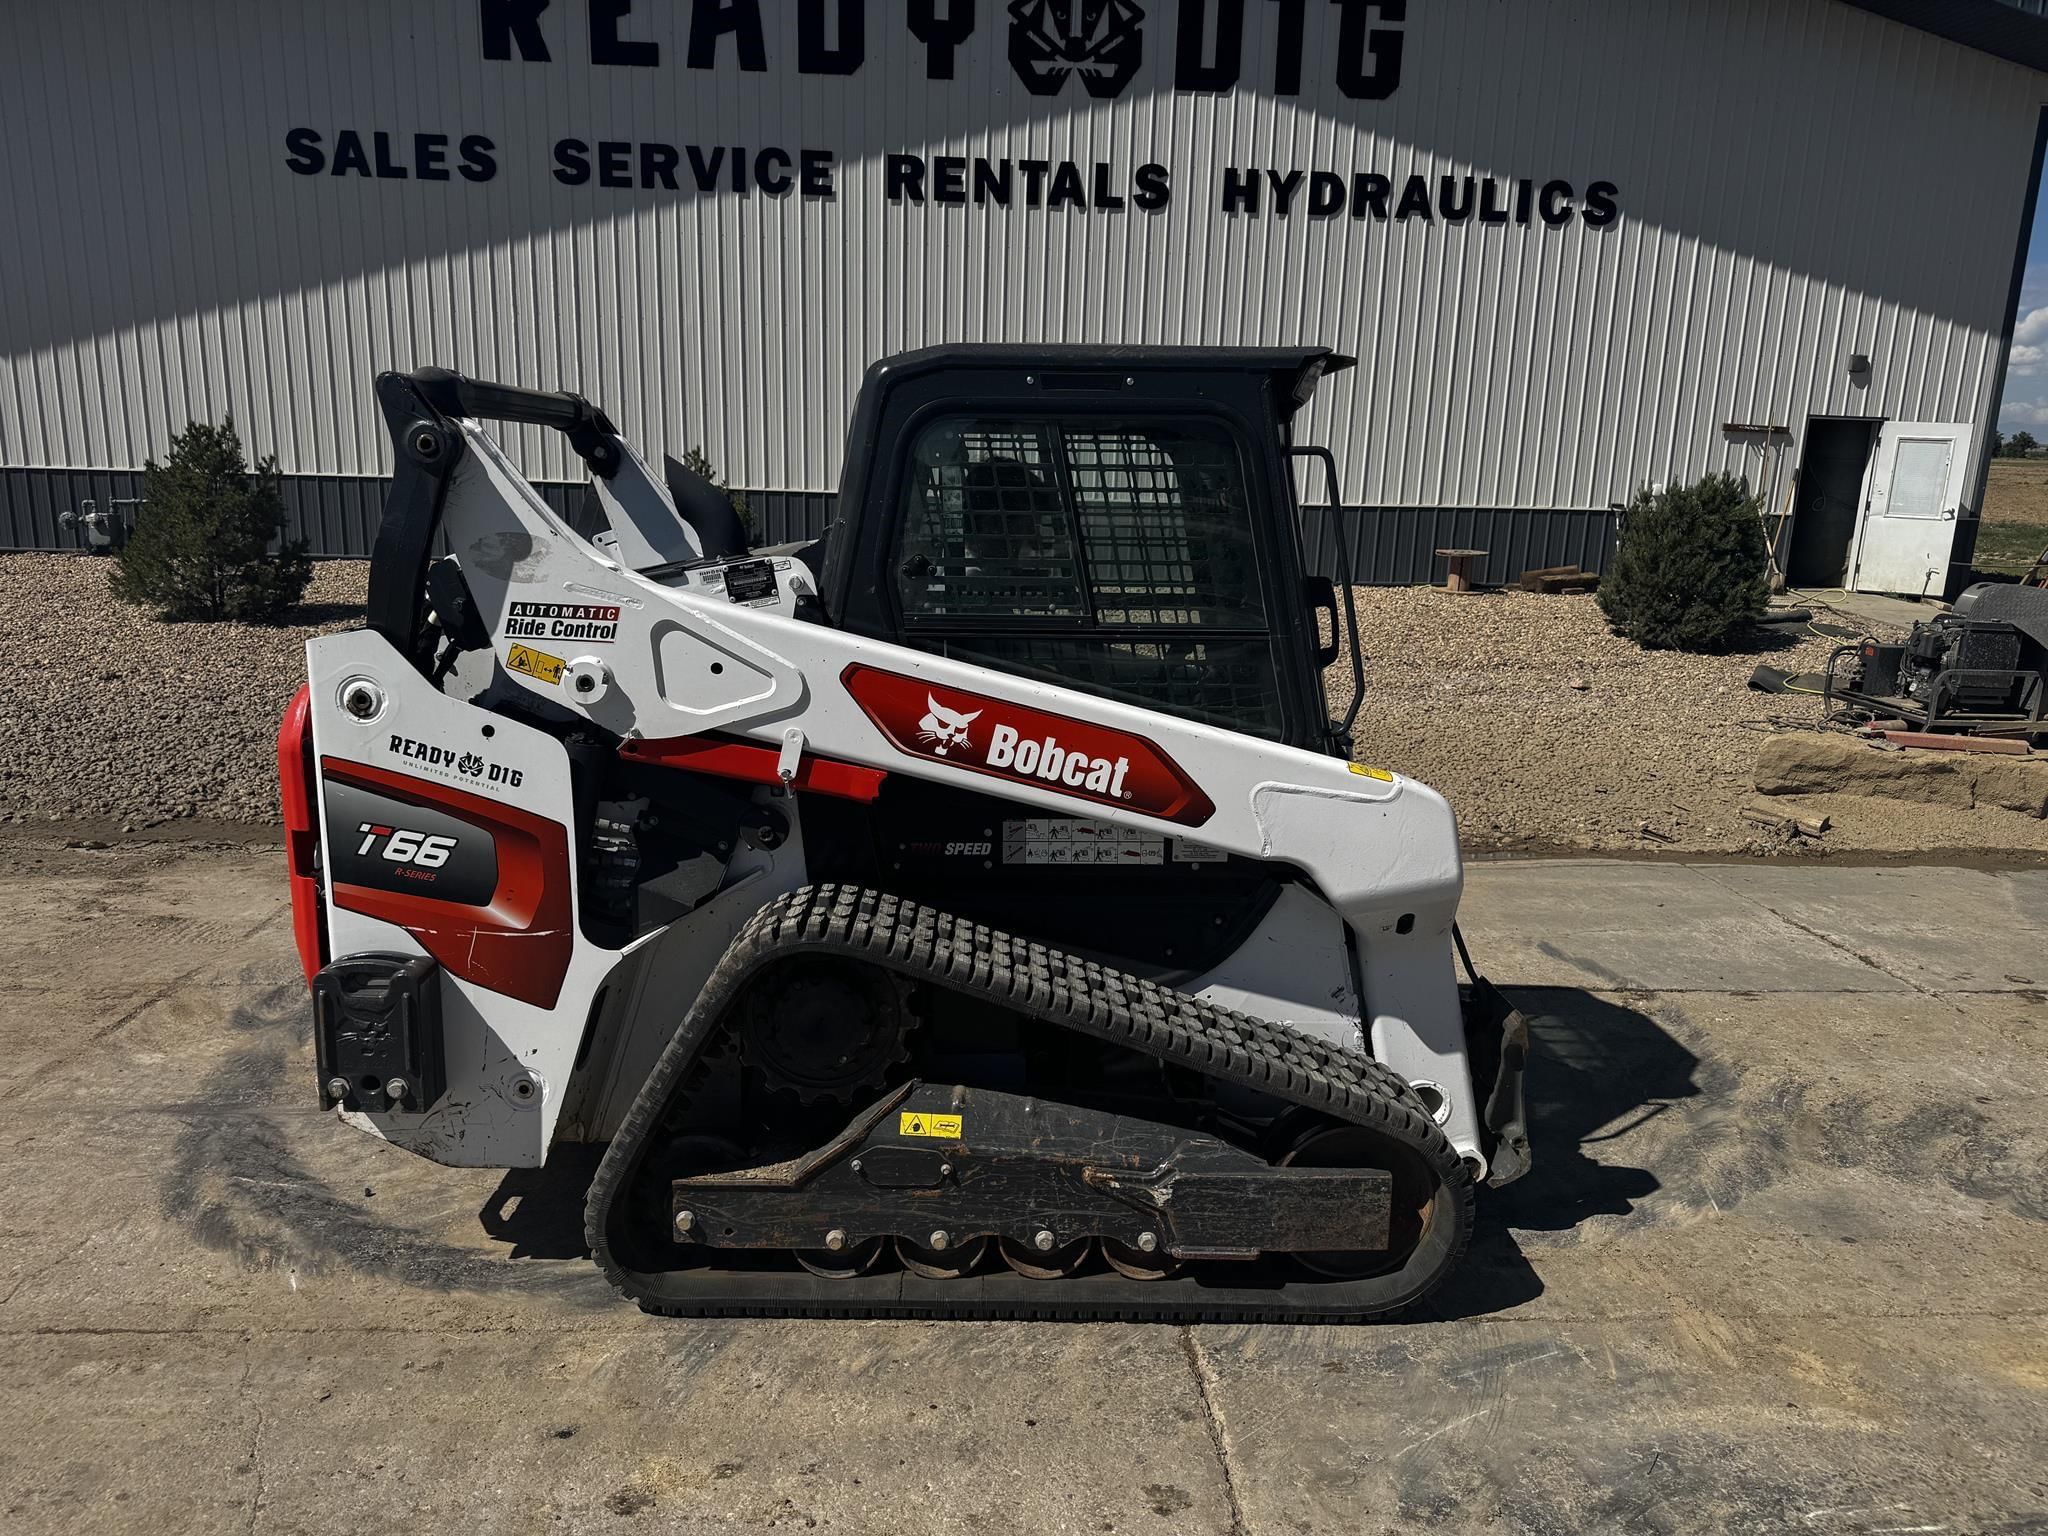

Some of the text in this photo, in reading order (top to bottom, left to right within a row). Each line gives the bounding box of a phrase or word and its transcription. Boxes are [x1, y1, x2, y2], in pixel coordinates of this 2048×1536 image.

[1174, 0, 1407, 99] DIG
[285, 128, 1620, 226] SALES SERVICE RENTALS HYDRAULICS
[505, 618, 617, 639] Ride Control
[513, 604, 617, 620] AUTOMATIC
[389, 734, 524, 788] READY DIG
[403, 760, 501, 793] UNLIMITED POTENTIAL
[986, 723, 1130, 798] Bobcat
[356, 823, 458, 869] T66
[945, 842, 992, 856] SPEED
[395, 867, 437, 882] R-SERIES
